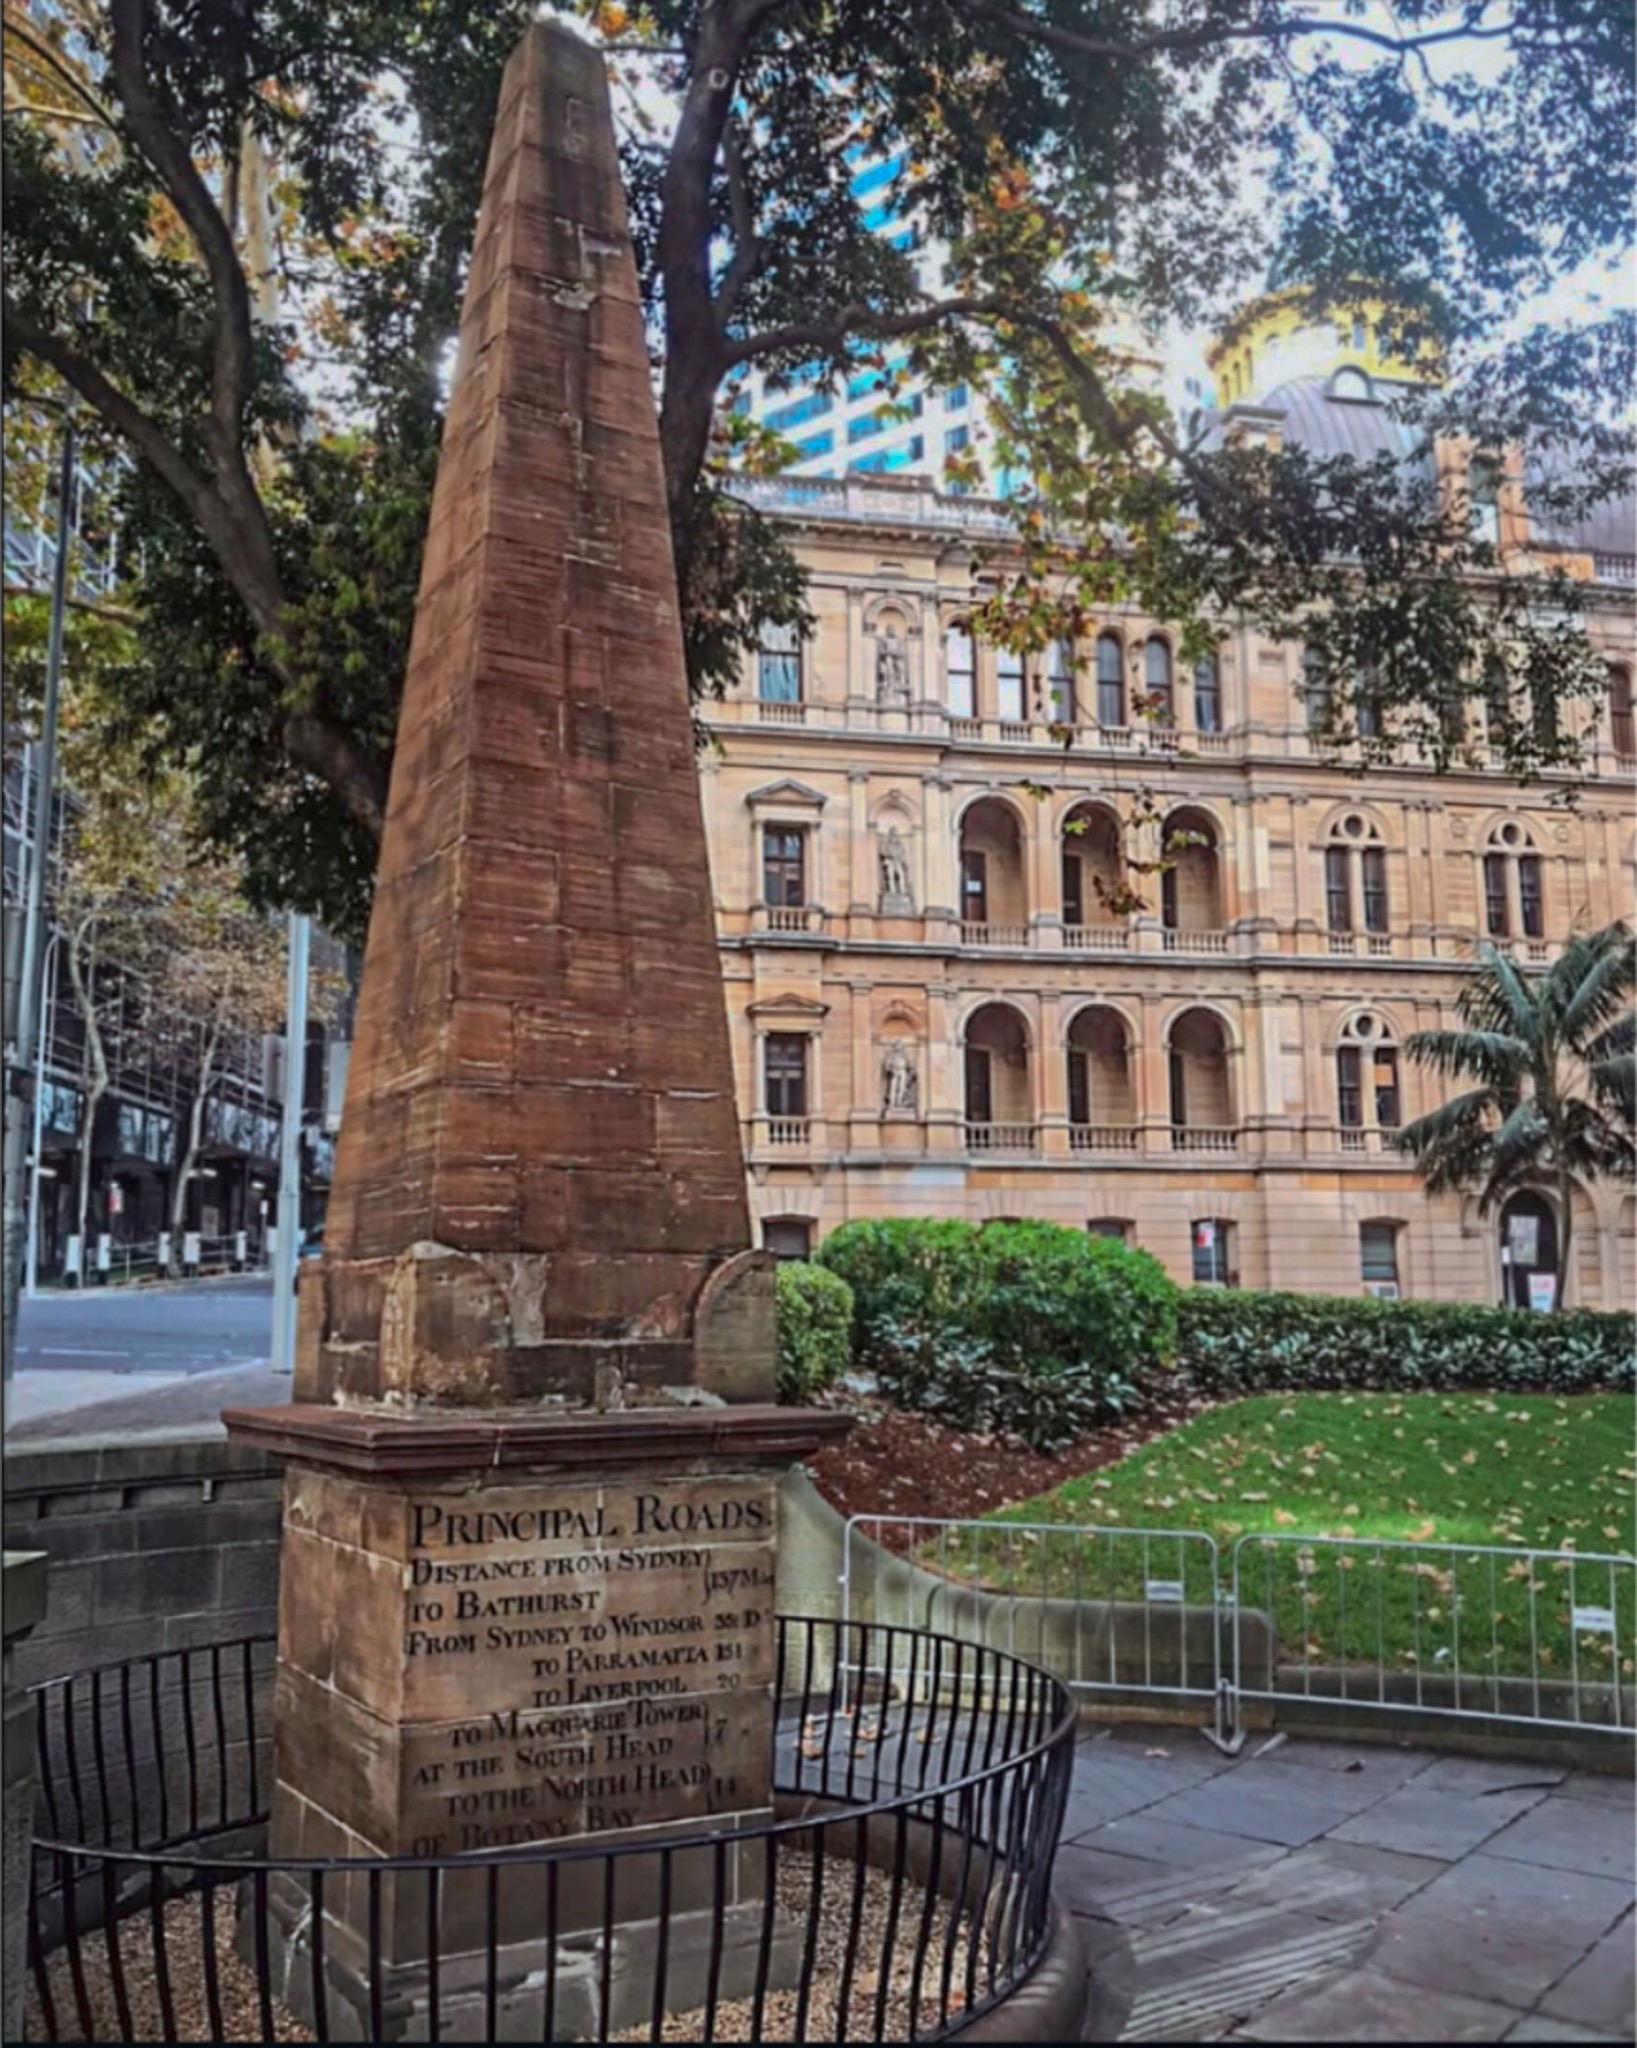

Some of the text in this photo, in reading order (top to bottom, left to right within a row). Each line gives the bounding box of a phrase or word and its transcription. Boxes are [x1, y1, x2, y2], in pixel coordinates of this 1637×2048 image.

[411, 1494, 773, 1548] PRINCIPAL ROADS.
[411, 1548, 702, 1587] DISTANCE FROM SYDNEY
[411, 1590, 600, 1623] TO BATHURST
[409, 1631, 477, 1657] FROM
[486, 1624, 574, 1650] SYDNEY
[580, 1622, 607, 1642] TO
[610, 1614, 704, 1637] WINDSOR
[532, 1657, 559, 1678] TO
[566, 1646, 709, 1674] PARRAMATTA
[532, 1673, 741, 1707] TO LIVERPOOL 20
[449, 1728, 482, 1748] TO
[491, 1710, 626, 1740] MACQUARIE
[627, 1701, 701, 1727] TOWER
[414, 1735, 673, 1786] AT THE SOUTH HEAD
[545, 1774, 626, 1803] NORTH
[636, 1763, 705, 1793] HEAD
[412, 1805, 643, 1858] OF BOTANY BAY
